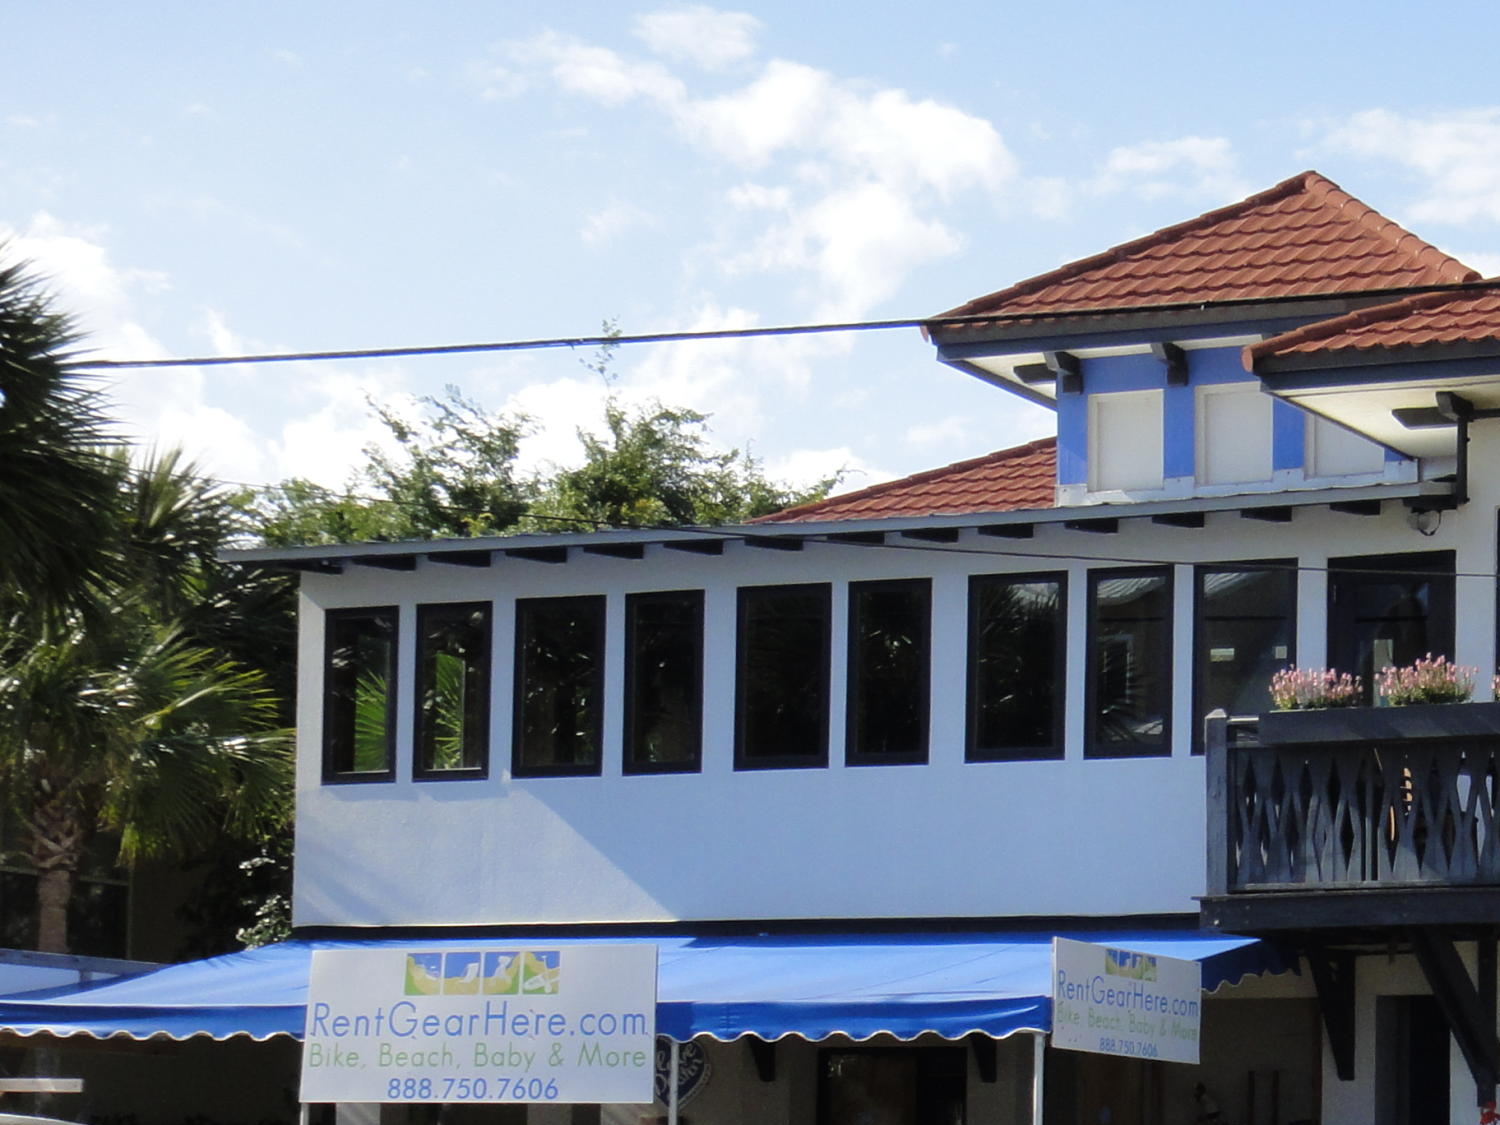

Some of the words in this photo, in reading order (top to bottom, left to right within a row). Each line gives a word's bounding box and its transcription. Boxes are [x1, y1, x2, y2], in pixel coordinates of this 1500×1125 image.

[1058, 970, 1199, 1016] RentGearHere.com
[312, 1001, 646, 1038] RentGearHere.com
[309, 1043, 367, 1069] Bike,
[379, 1043, 462, 1069] Beach,
[474, 1043, 536, 1072] Baby
[549, 1043, 564, 1067] &
[577, 1043, 646, 1067] More
[387, 1078, 559, 1100] 888.750.7606
